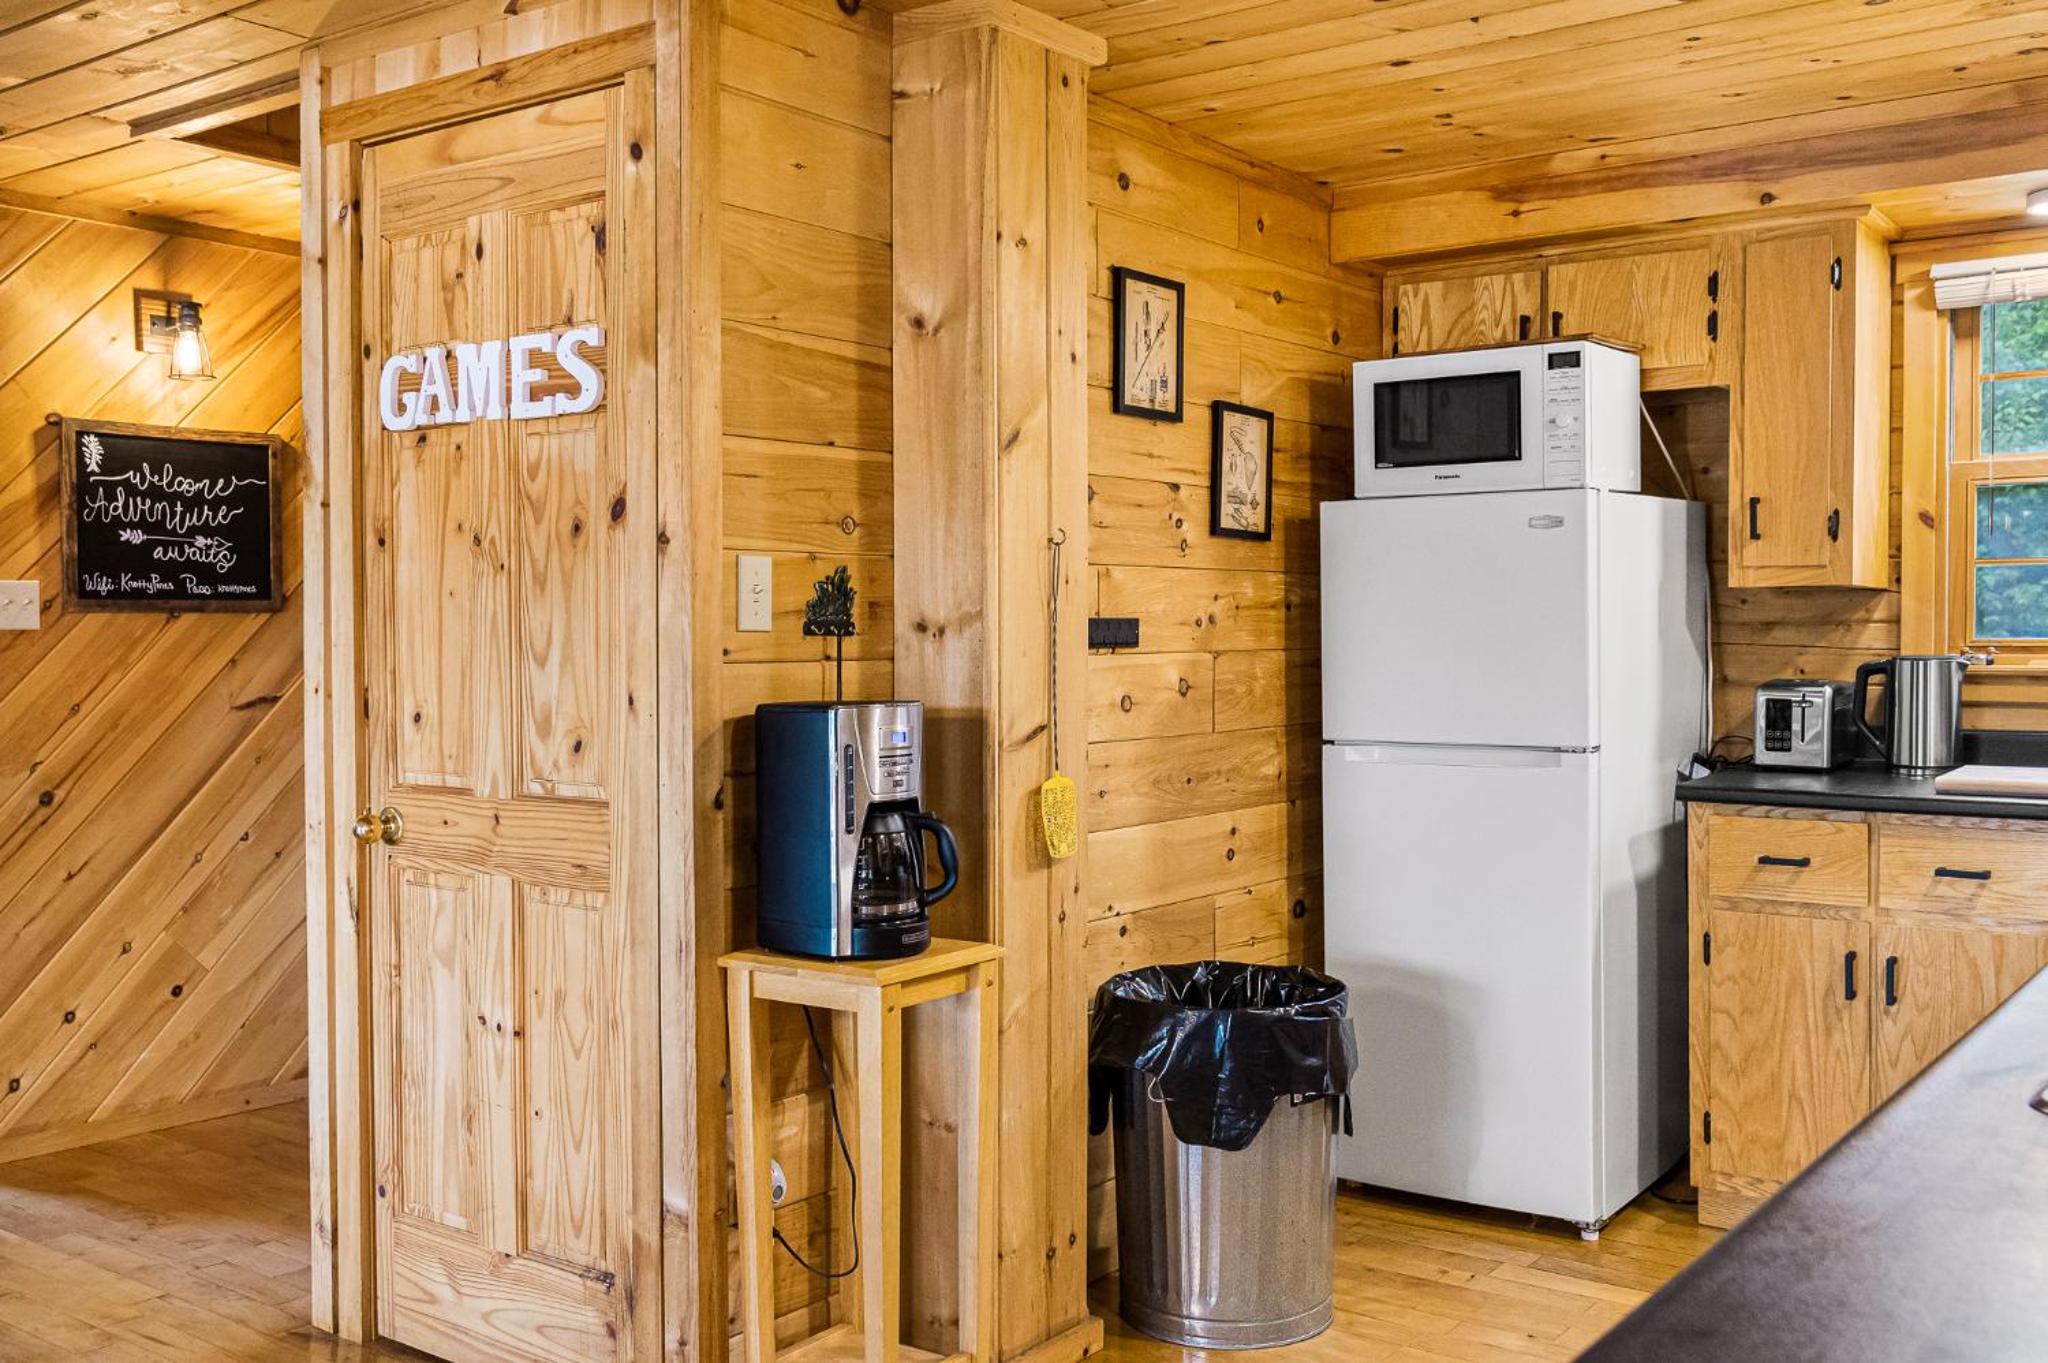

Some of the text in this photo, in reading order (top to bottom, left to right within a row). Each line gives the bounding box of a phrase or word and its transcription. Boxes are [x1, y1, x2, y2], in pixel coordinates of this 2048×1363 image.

[380, 327, 605, 431] GAMES
[90, 463, 266, 499] Welcome
[84, 487, 244, 533] Adventure
[153, 545, 237, 573] awaits
